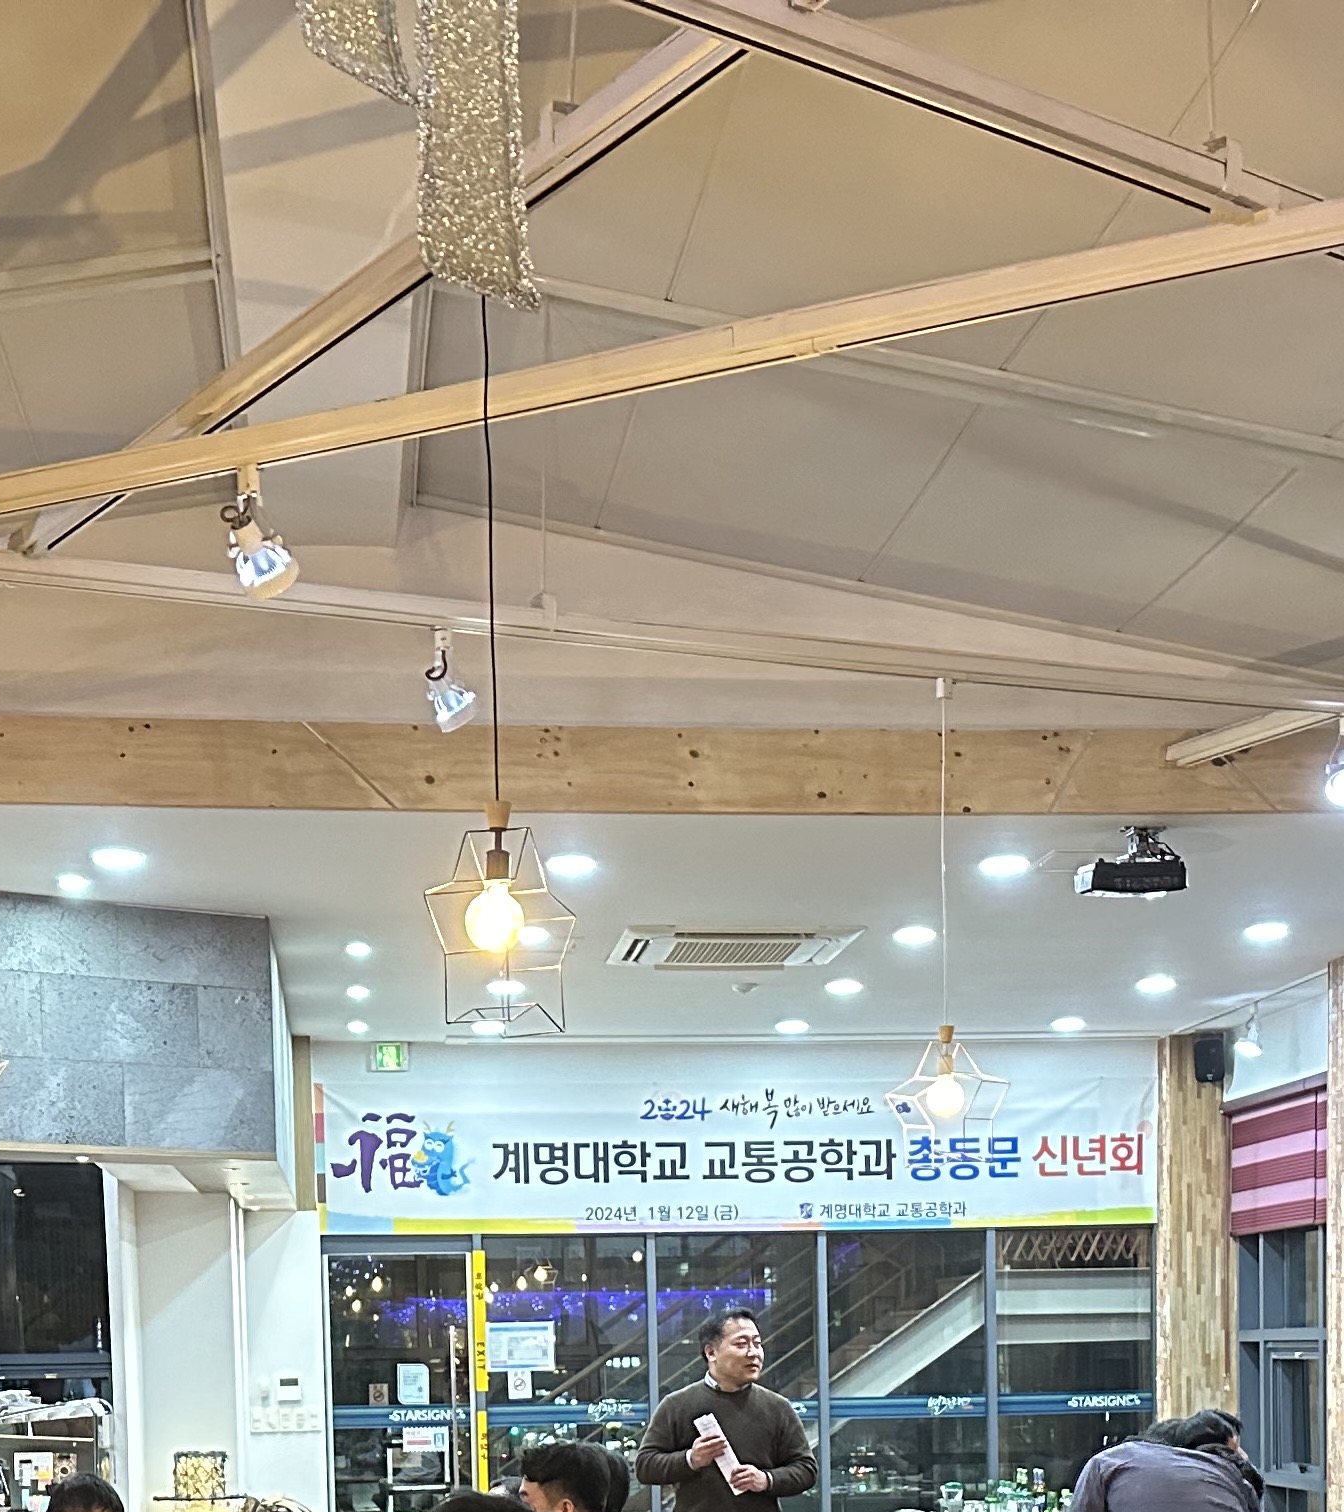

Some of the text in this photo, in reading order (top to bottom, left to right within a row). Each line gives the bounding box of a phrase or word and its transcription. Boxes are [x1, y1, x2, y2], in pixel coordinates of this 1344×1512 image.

[719, 1094, 758, 1116] 새해
[762, 1088, 779, 1129] 복
[784, 1094, 812, 1118] 많이
[817, 1096, 875, 1117] 받으세요
[491, 1133, 1144, 1185] 계명대학교 교통공학과 총동문 신년회
[585, 1204, 739, 1222] 2024년 1월 12일 (금)
[819, 1201, 967, 1220] 계명대학교 교통공학과
